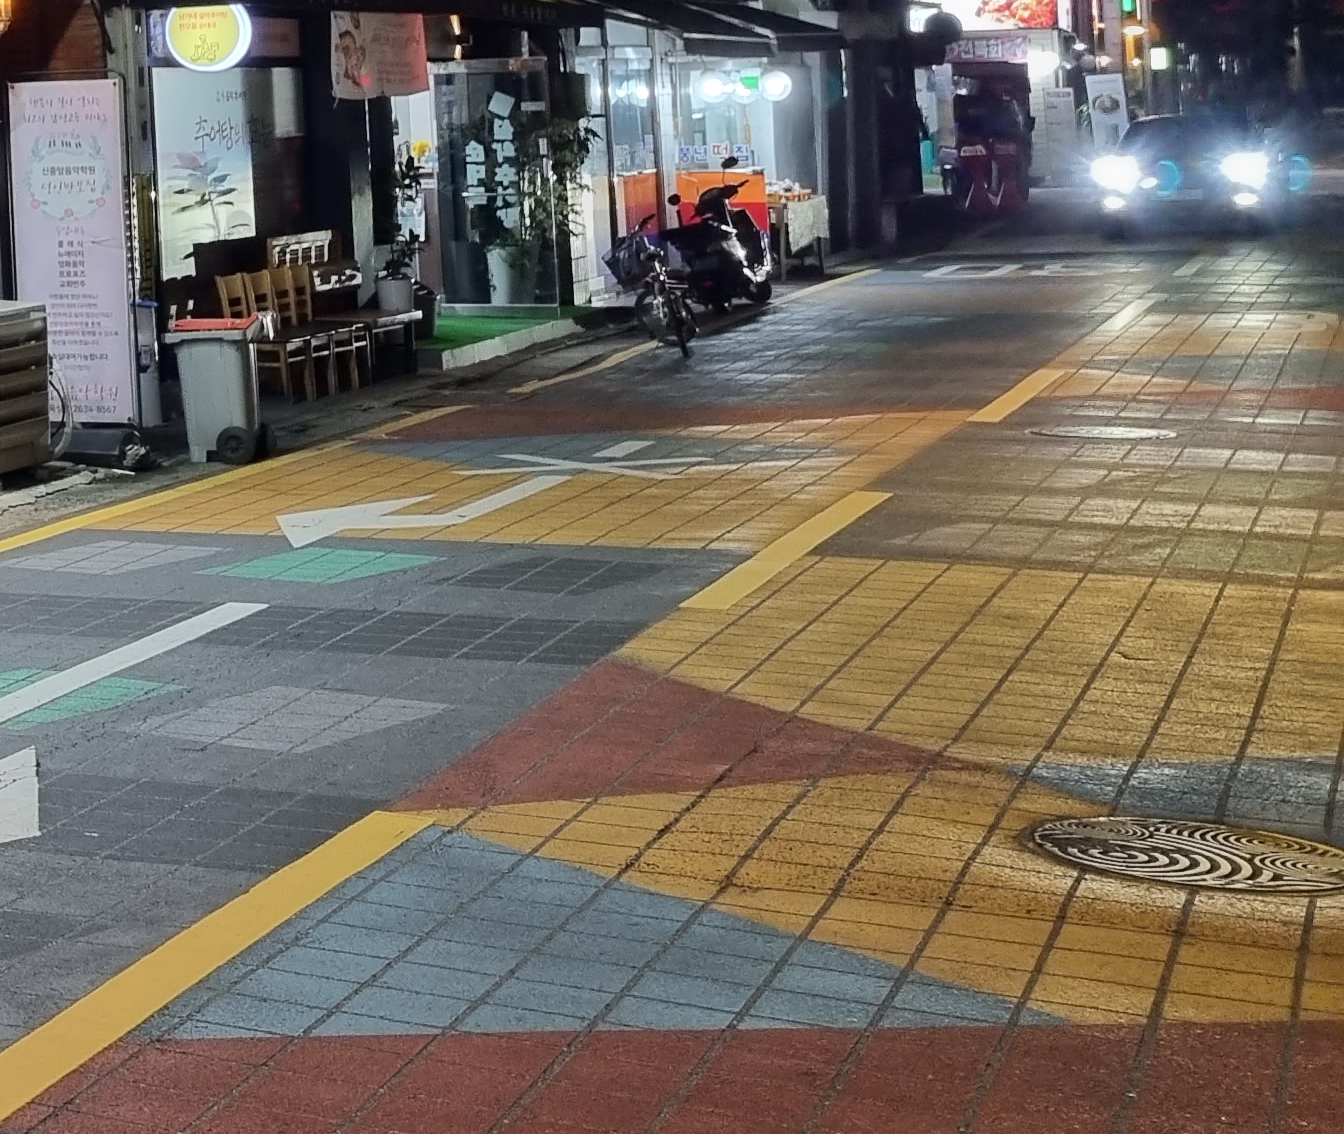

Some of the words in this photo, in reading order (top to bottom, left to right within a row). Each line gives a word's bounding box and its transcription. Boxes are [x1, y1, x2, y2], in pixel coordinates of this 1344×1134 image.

[194, 115, 247, 154] 추어탕의
[42, 165, 96, 176] 신중앙음악학원
[57, 260, 85, 268] 영화음악
[59, 280, 86, 289] 교회반주
[73, 404, 118, 414] 2634-8567
